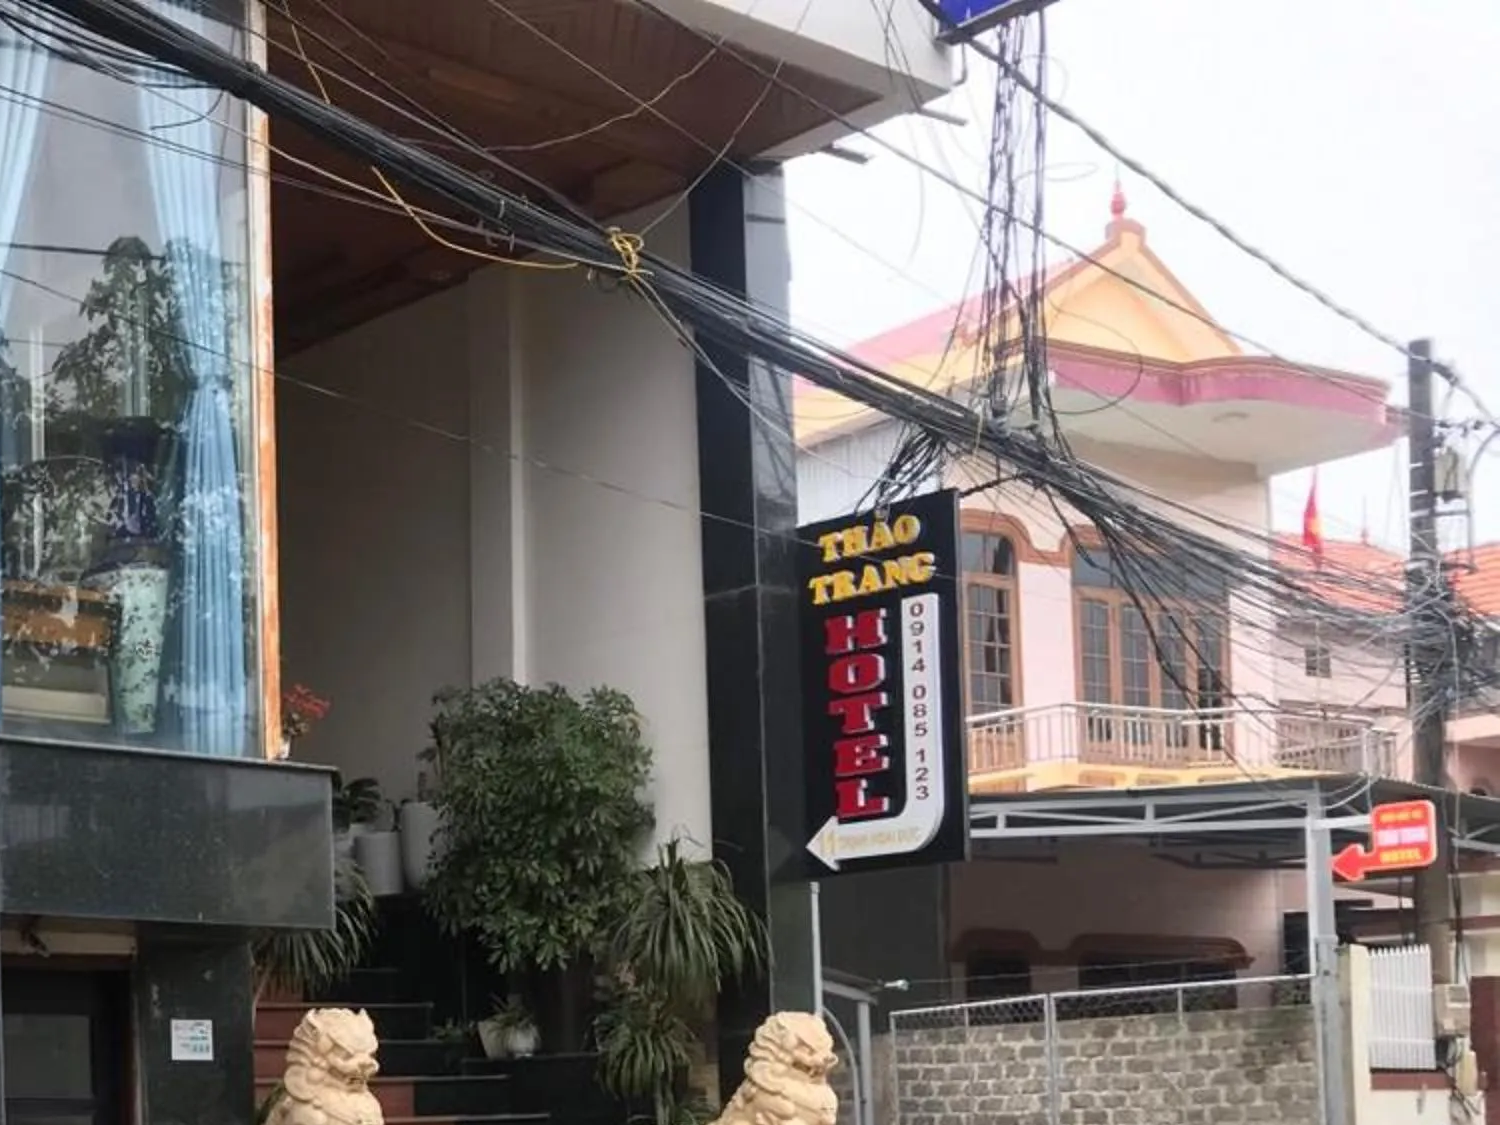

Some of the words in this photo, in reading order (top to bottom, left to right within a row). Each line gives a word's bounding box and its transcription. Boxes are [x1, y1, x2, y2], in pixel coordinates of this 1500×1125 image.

[808, 552, 936, 605] TRANG
[909, 603, 926, 673] 0914
[826, 607, 889, 819] HOTEL
[912, 685, 928, 737] 085
[915, 749, 930, 801] 123
